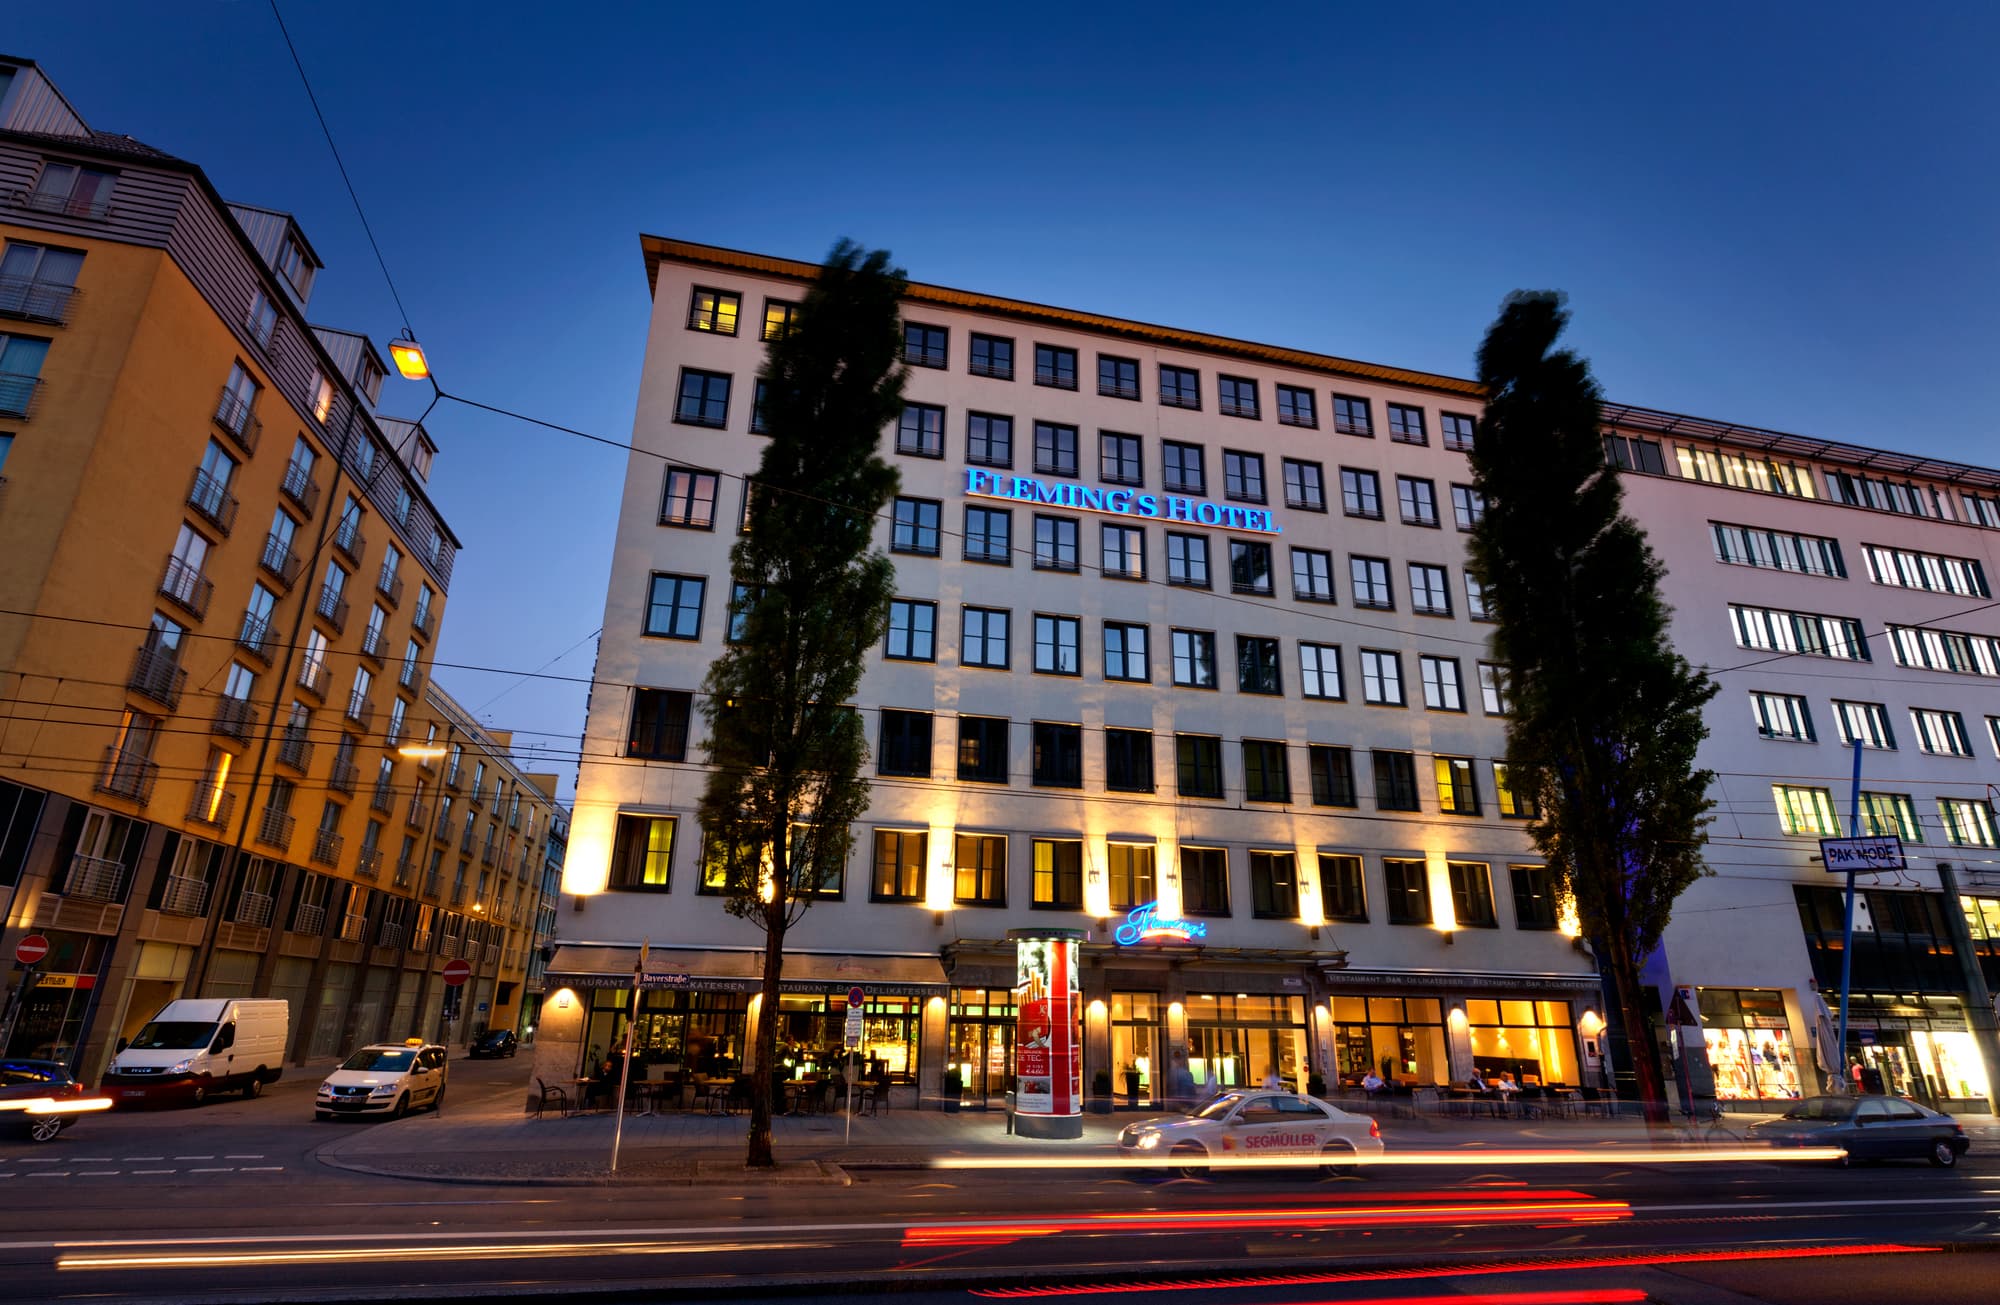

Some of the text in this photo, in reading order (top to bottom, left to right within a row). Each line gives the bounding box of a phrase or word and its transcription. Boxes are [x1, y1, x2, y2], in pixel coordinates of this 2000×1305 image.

[965, 467, 1283, 534] FLEMING'S HOTEL
[1829, 845, 1895, 863] PAK MODE
[551, 977, 625, 988] RESTAURANT
[643, 973, 688, 984] Bayerstraße
[1329, 975, 1380, 983] RESTAURANT
[1407, 977, 1463, 985] DELIKATESSEN
[1473, 978, 1520, 986] RESTAURANT
[865, 985, 941, 996] DELIKATESSEN
[1246, 1133, 1316, 1149] SEGMÜLLER
